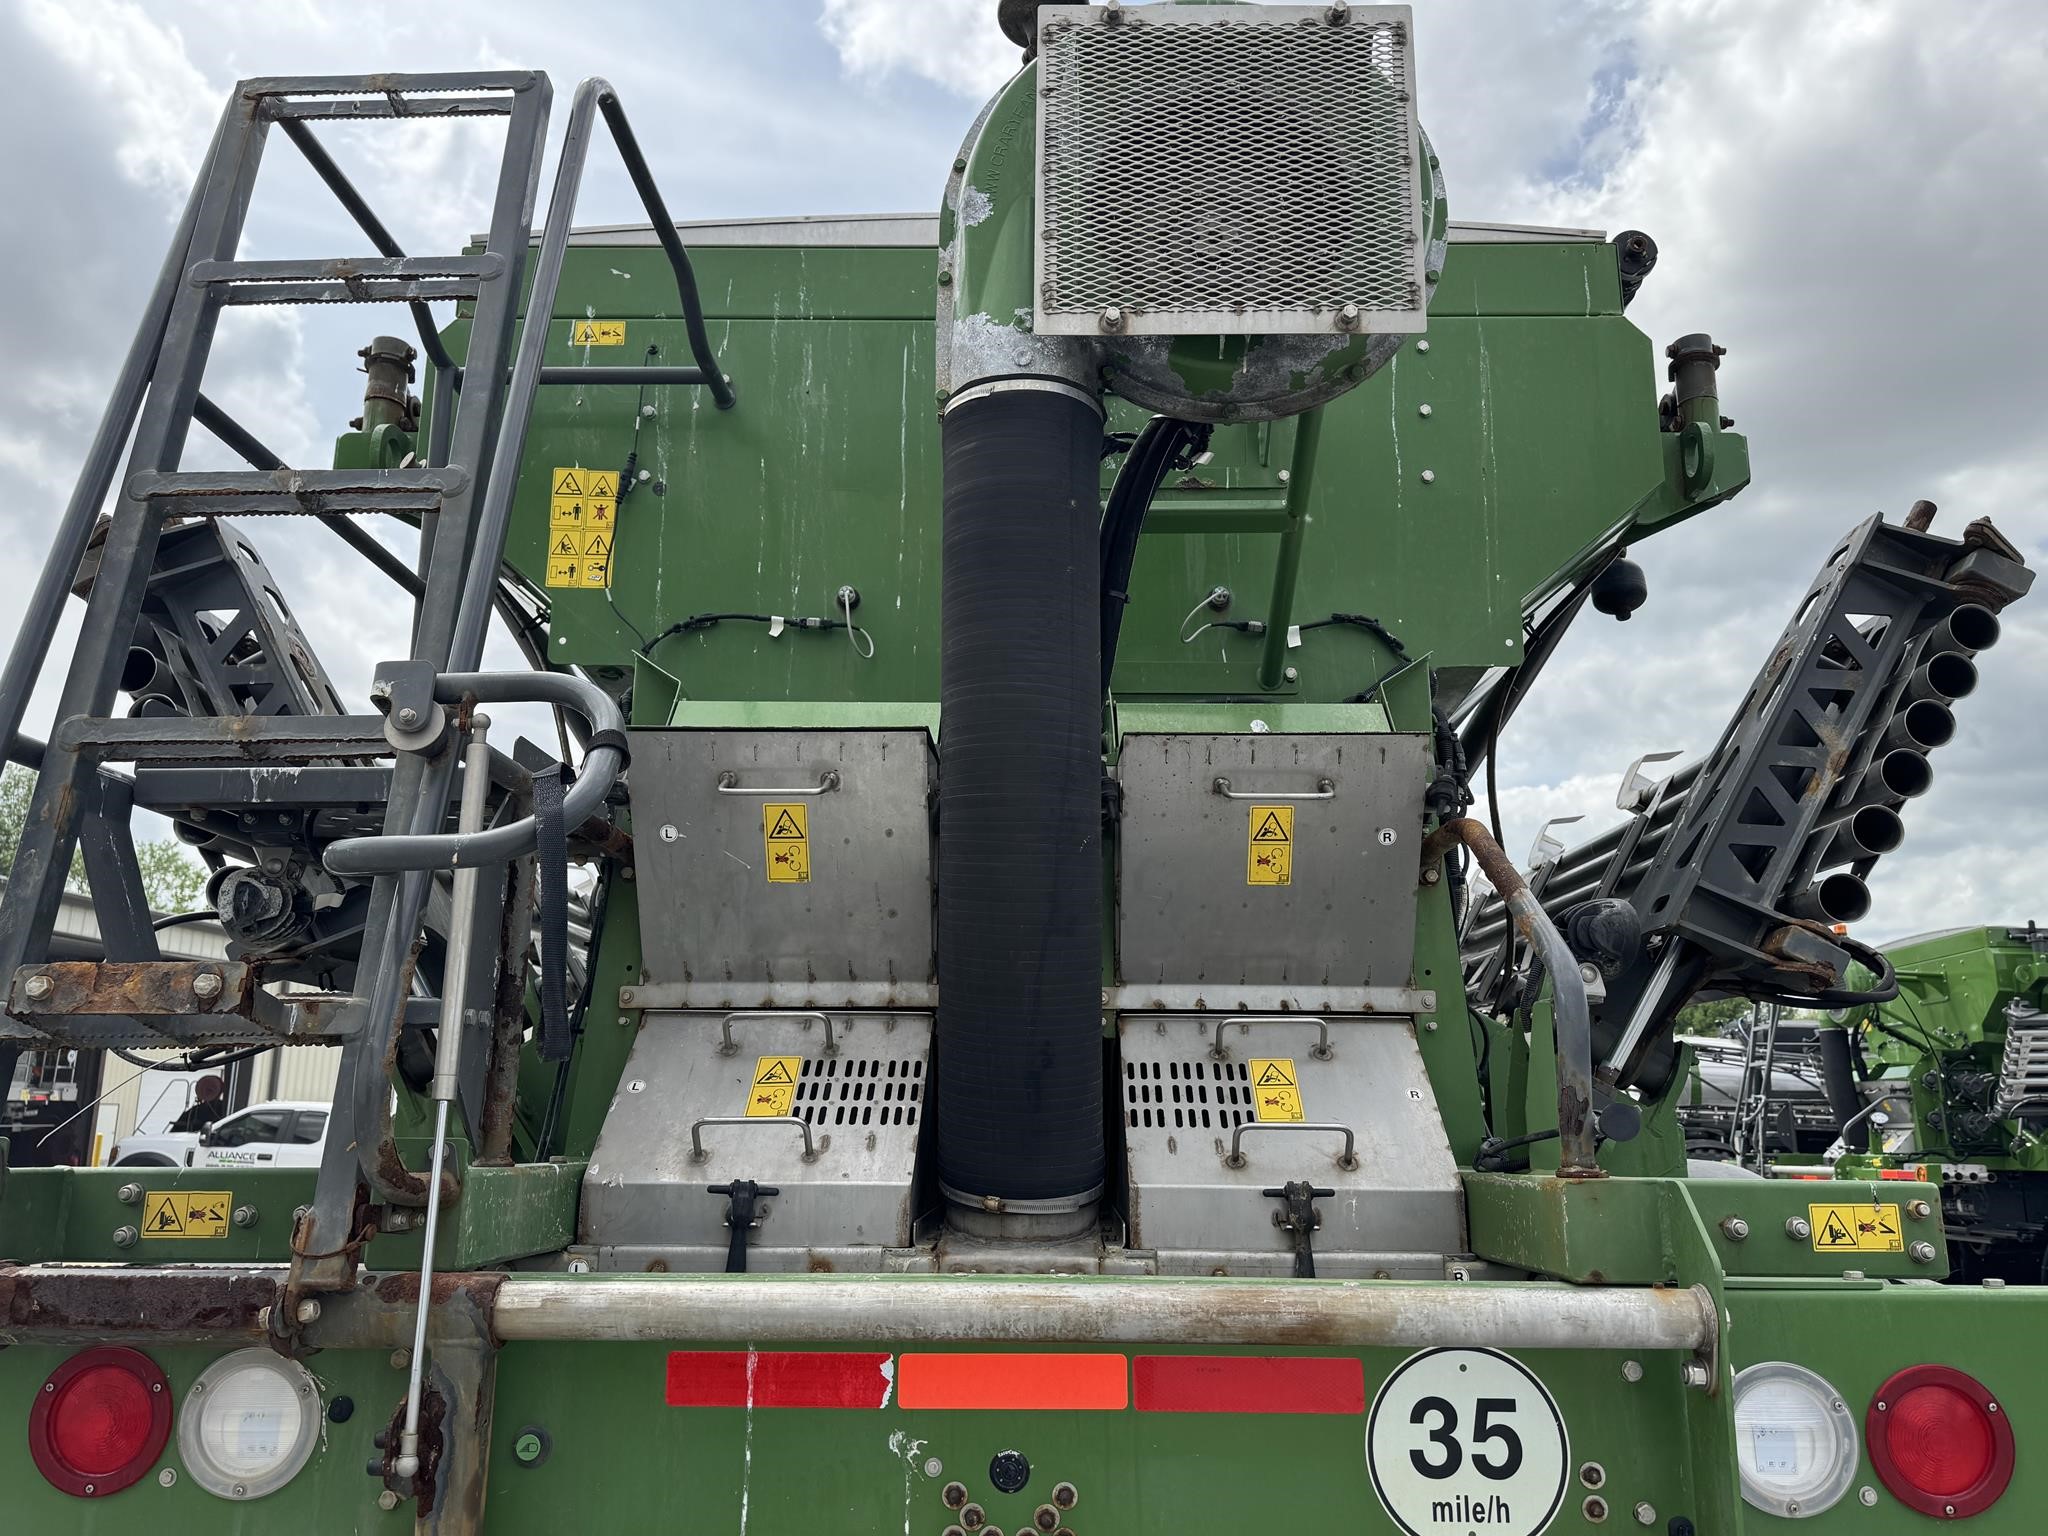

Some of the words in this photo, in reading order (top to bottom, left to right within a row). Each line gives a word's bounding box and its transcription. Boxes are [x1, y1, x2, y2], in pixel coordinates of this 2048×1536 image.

[665, 828, 673, 839] L
[1382, 832, 1392, 843] R
[631, 1082, 640, 1091] L
[1409, 1090, 1420, 1099] R
[208, 1151, 256, 1161] ALLIANCE
[1454, 1271, 1464, 1281] R
[1409, 1396, 1523, 1480] 35
[1432, 1495, 1510, 1523] mile/h
